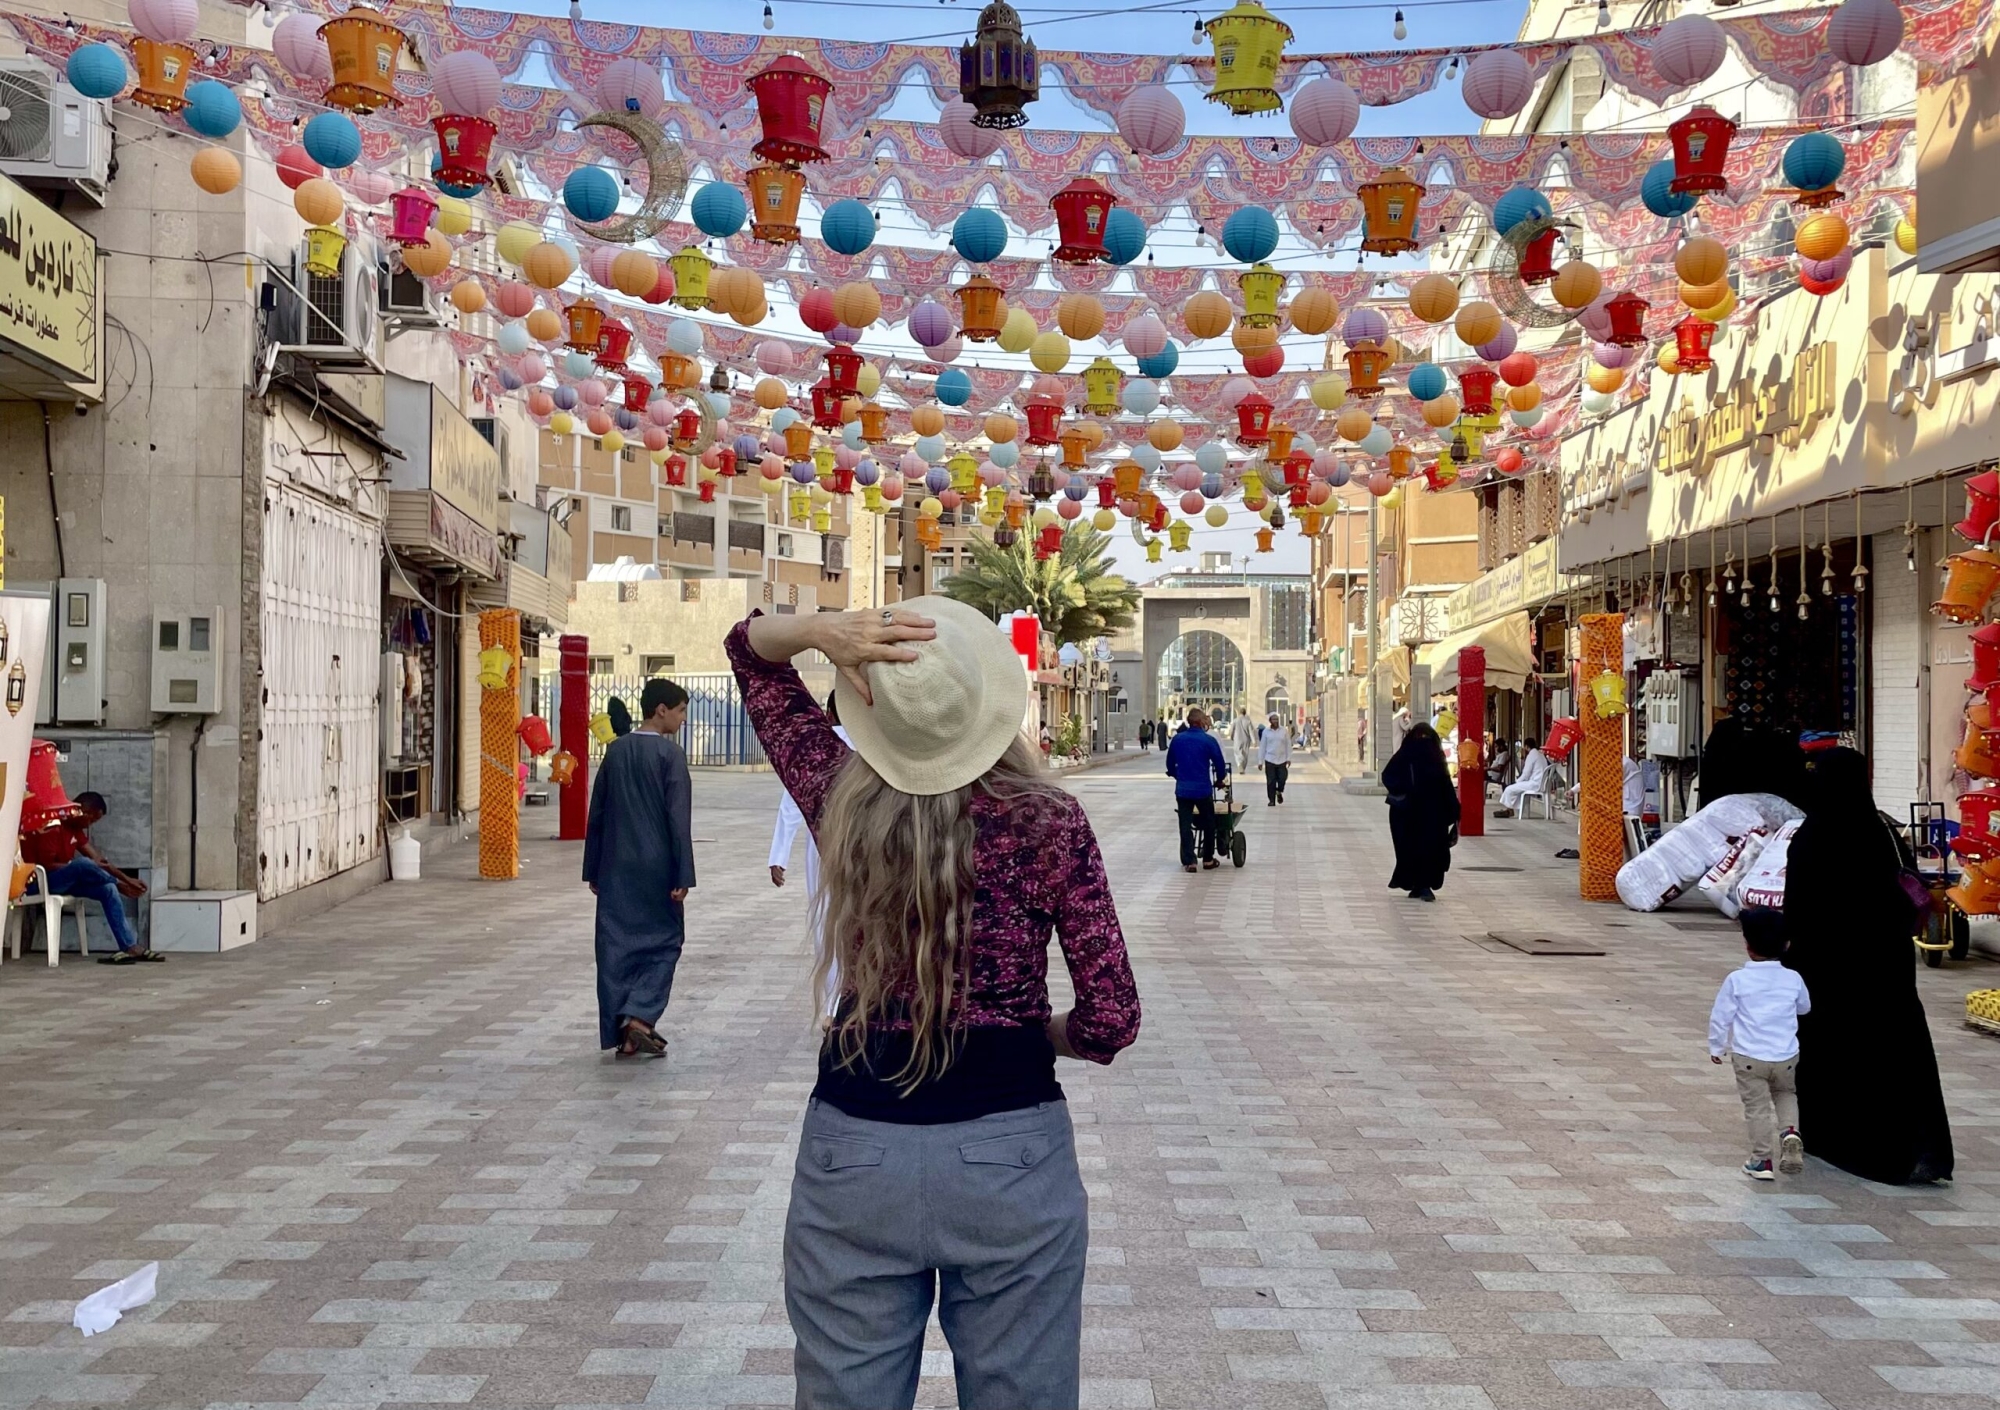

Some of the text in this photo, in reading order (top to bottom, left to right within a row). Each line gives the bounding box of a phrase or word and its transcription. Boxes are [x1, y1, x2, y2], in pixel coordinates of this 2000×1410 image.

[25, 223, 73, 299] ناردين
[26, 304, 59, 340] عطورات
[1747, 891, 1771, 906] PLUS
